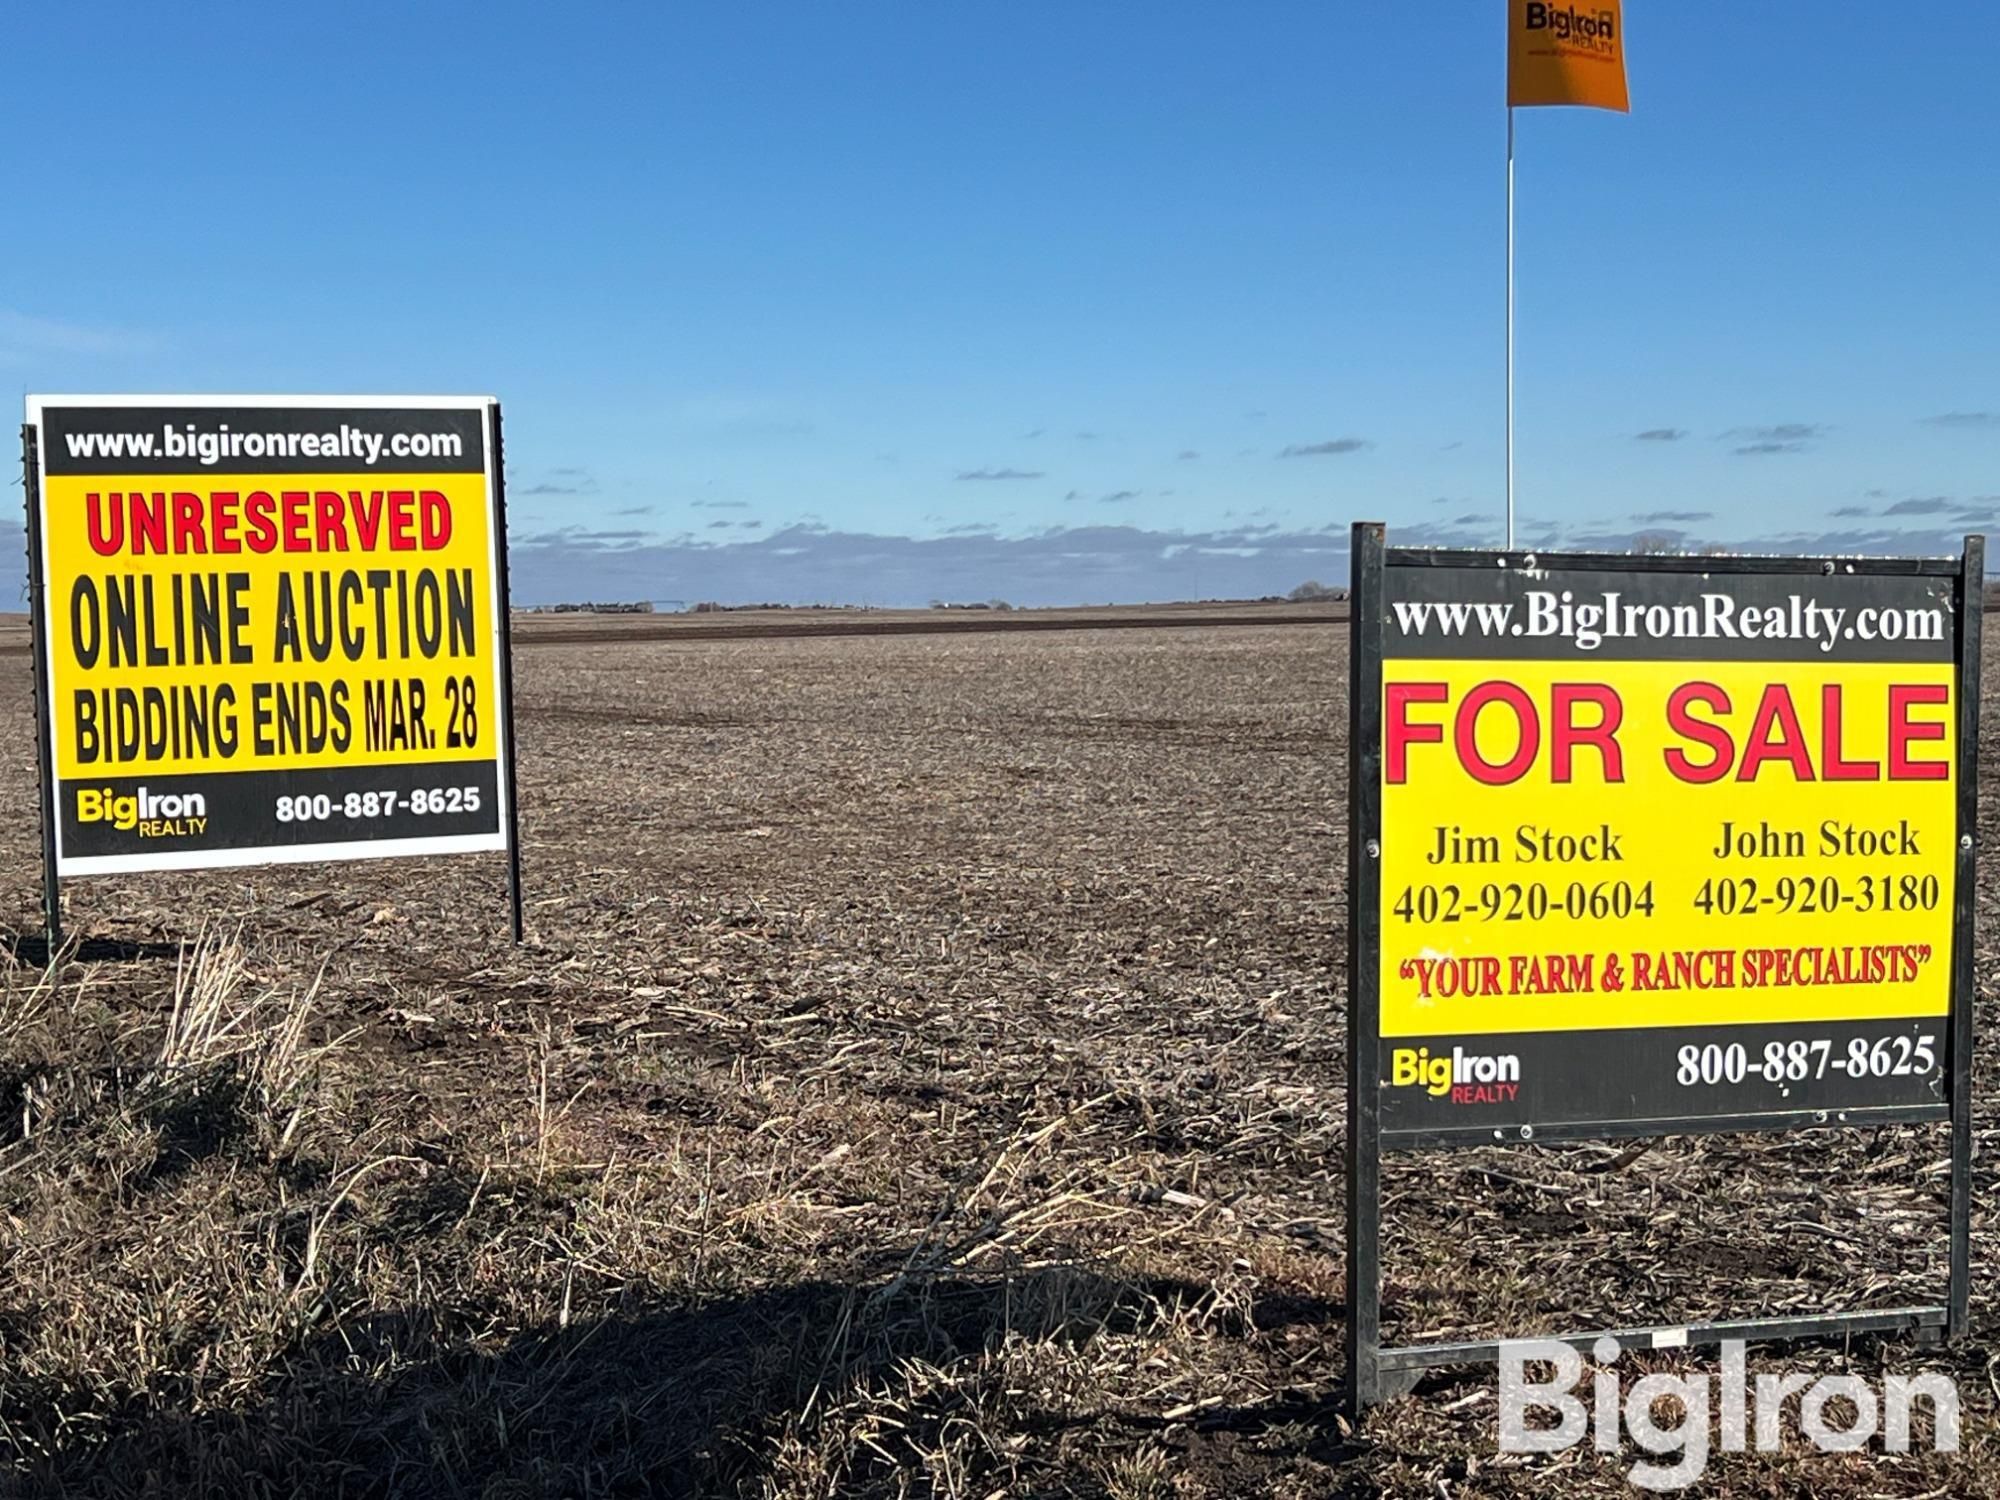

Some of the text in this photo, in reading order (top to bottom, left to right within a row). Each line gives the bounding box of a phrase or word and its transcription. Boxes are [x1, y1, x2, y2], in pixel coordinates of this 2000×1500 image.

[1526, 2, 1614, 39] BigIron
[65, 424, 462, 465] www.bigironrealty.com
[86, 490, 452, 556] UNRESERVED
[70, 567, 477, 670] ONLINE AUCTION
[1391, 591, 1945, 652] www.BigIronRealty.com
[73, 675, 479, 764] BIDDING ENDS MAR. 28
[1384, 680, 1951, 786] FOR SALE
[77, 786, 207, 830] BigIron
[275, 786, 481, 823] 800-887-8625
[138, 817, 208, 838] REALTY
[1426, 824, 1625, 866] Jim Stock
[1713, 819, 1922, 860] John Stock
[1393, 880, 1655, 925] 402-920-0604
[1693, 874, 1941, 916] 402-920-3180
[1508, 953, 1595, 996] FARM
[1599, 954, 1626, 992] &
[1632, 949, 1737, 991] RANCH
[1392, 1045, 1520, 1096] BigIron
[1676, 1036, 1936, 1086] 800-887-8625
[1452, 1084, 1519, 1104] REALTY
